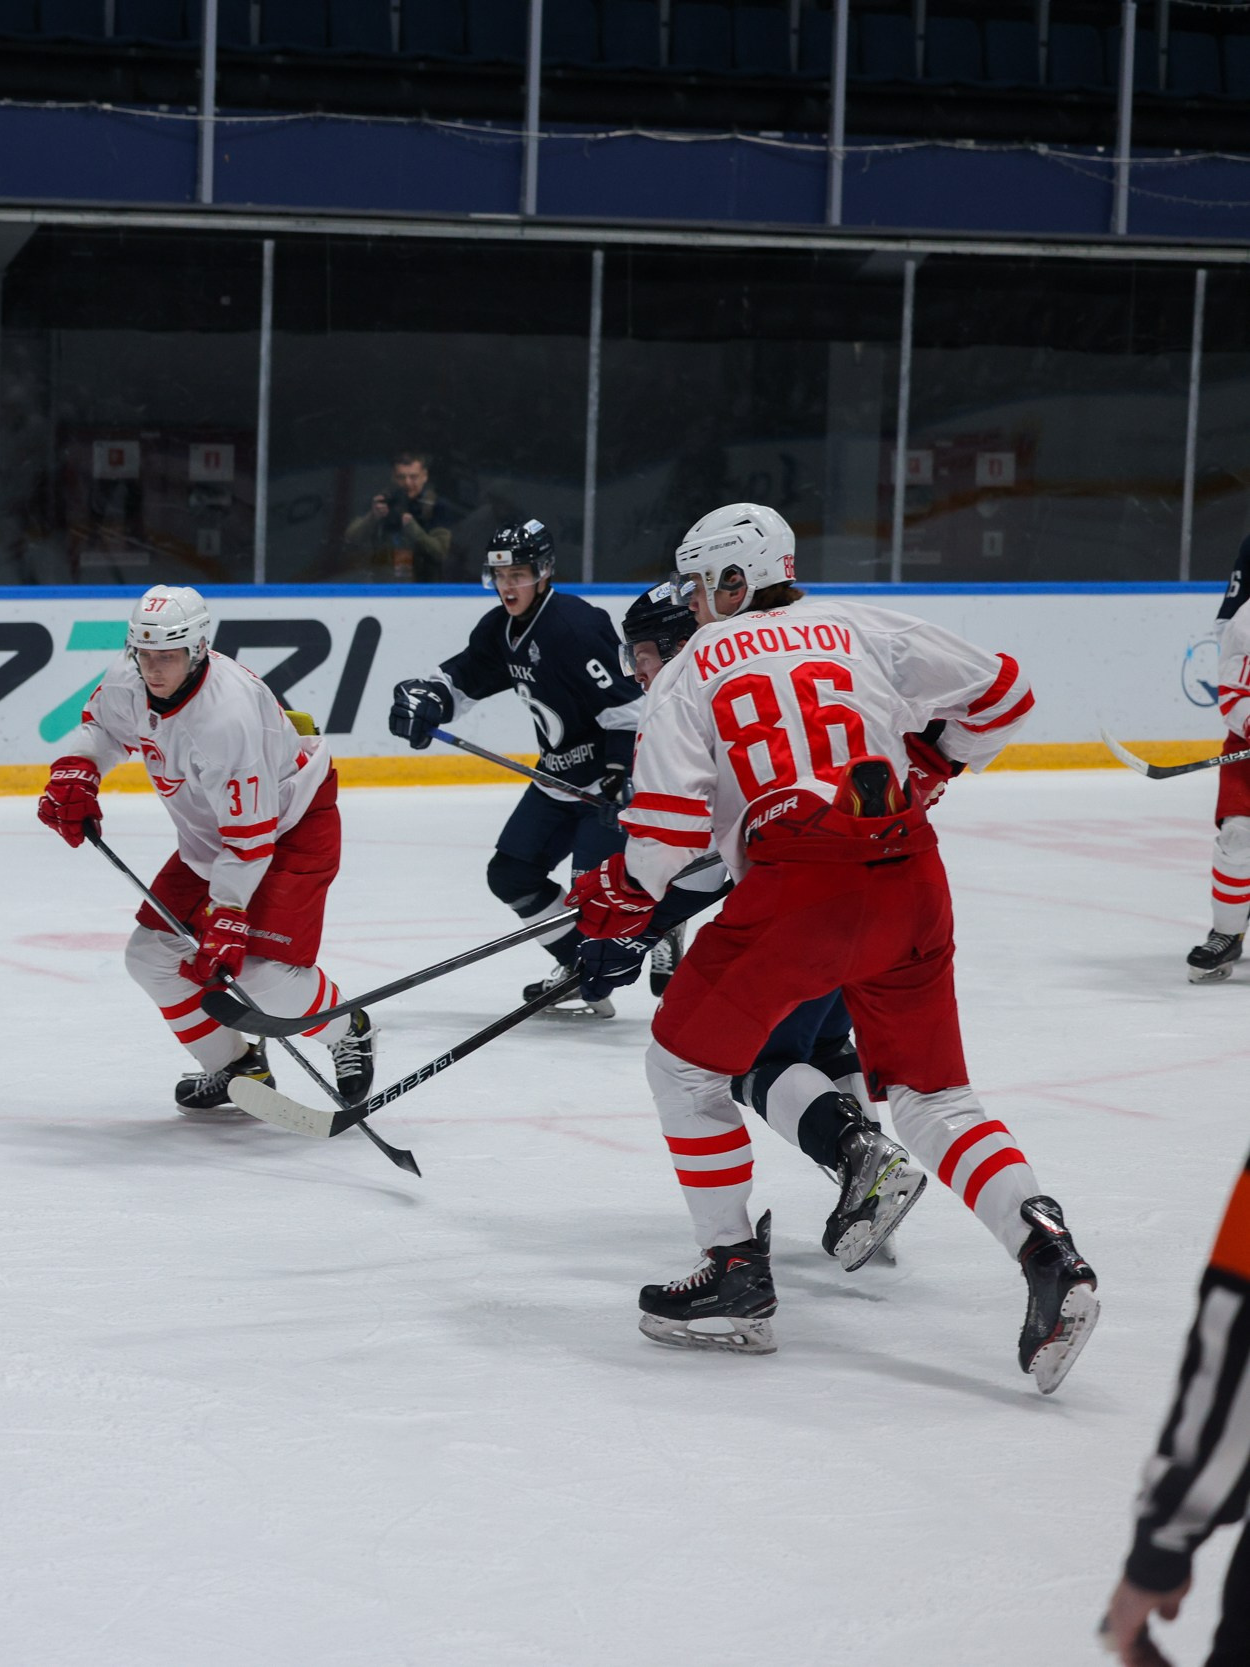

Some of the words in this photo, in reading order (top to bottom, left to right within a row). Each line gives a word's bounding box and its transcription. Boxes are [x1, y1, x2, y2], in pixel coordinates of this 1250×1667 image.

[144, 598, 167, 612] 37
[694, 624, 851, 681] KOROLYOV
[586, 658, 613, 689] 9
[711, 661, 868, 803] 86
[227, 775, 259, 816] 37
